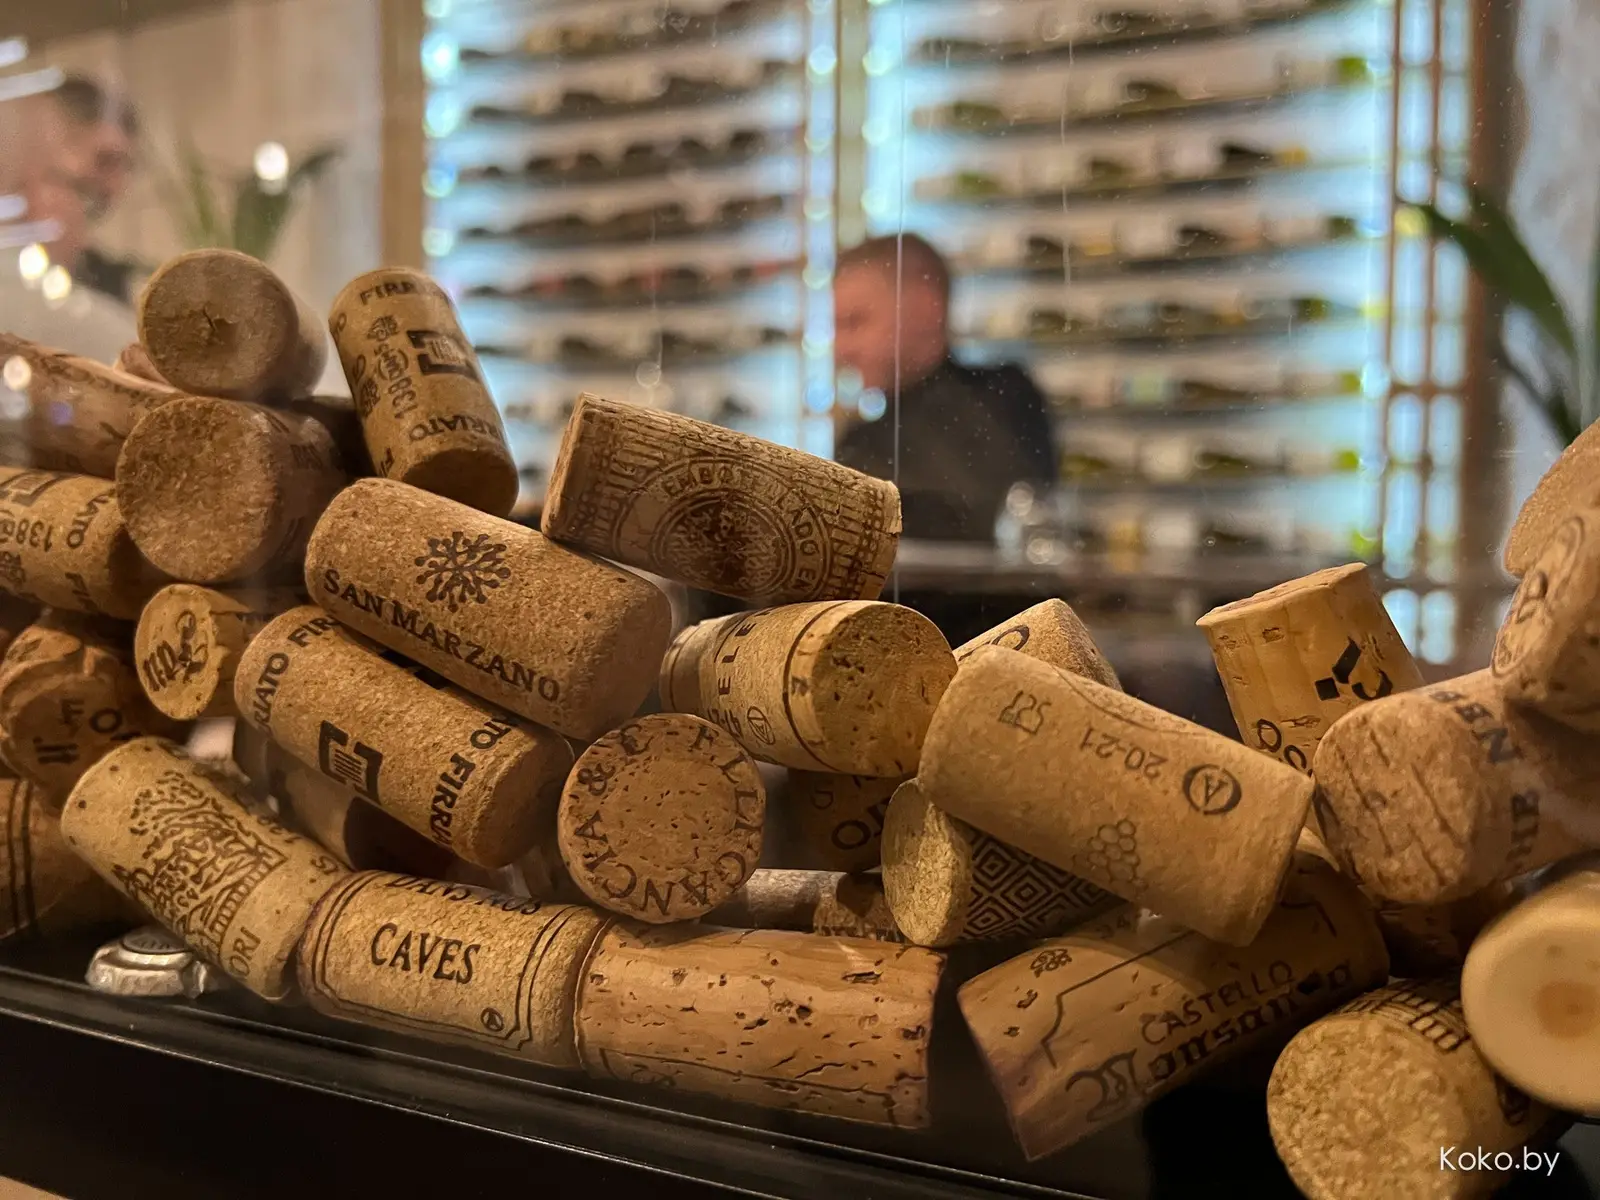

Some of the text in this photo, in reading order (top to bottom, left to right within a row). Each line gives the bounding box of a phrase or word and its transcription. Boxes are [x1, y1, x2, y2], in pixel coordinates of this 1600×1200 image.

[323, 568, 561, 703] SAN MARZANO
[370, 922, 482, 985] CAVES
[1140, 959, 1294, 1047] CASTELLO
